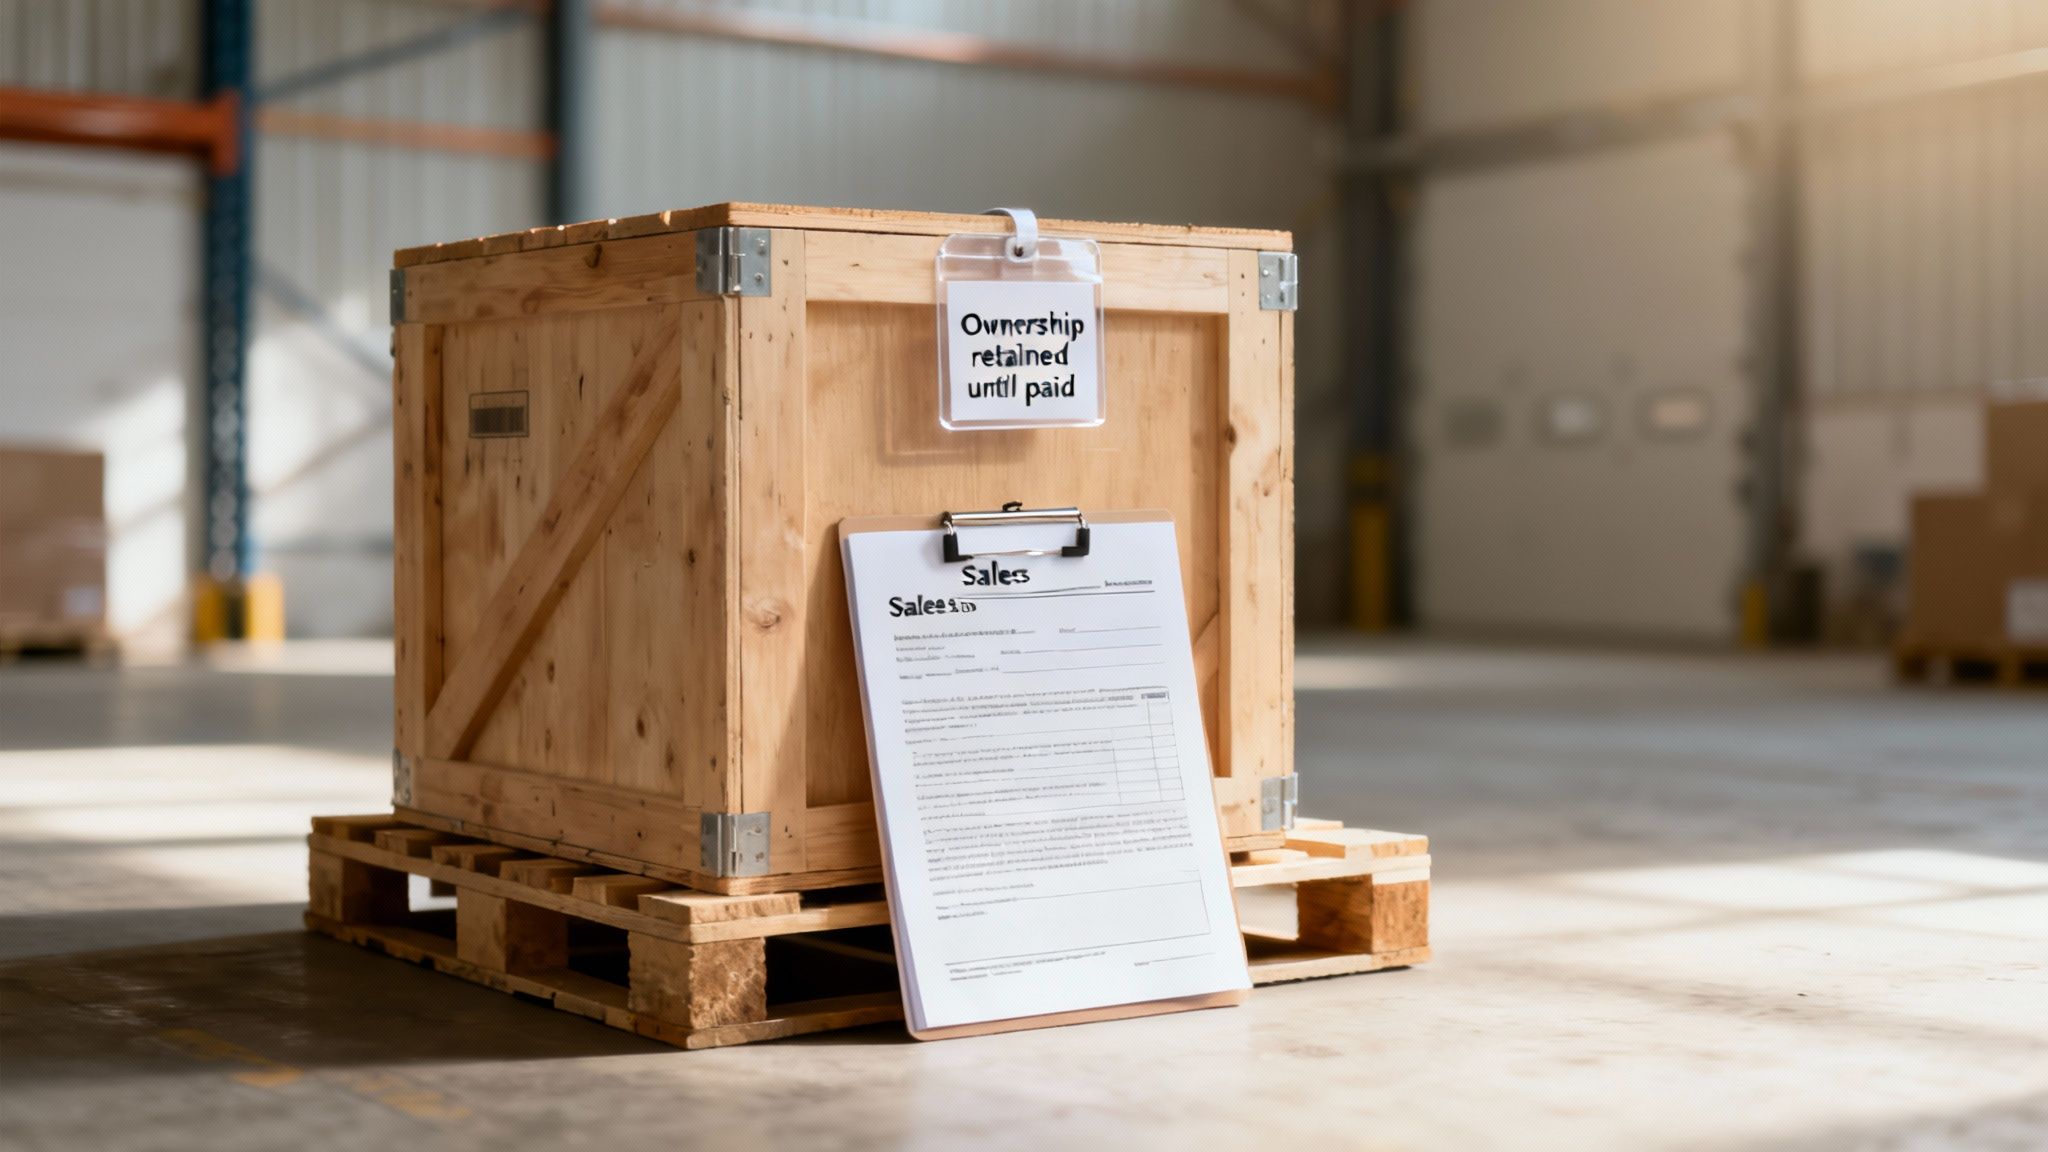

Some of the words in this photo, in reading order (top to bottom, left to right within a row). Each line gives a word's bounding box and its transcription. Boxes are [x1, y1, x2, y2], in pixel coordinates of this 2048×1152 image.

[961, 311, 1084, 341] Ownership
[1025, 373, 1075, 406] paid
[962, 560, 1031, 586] Sales
